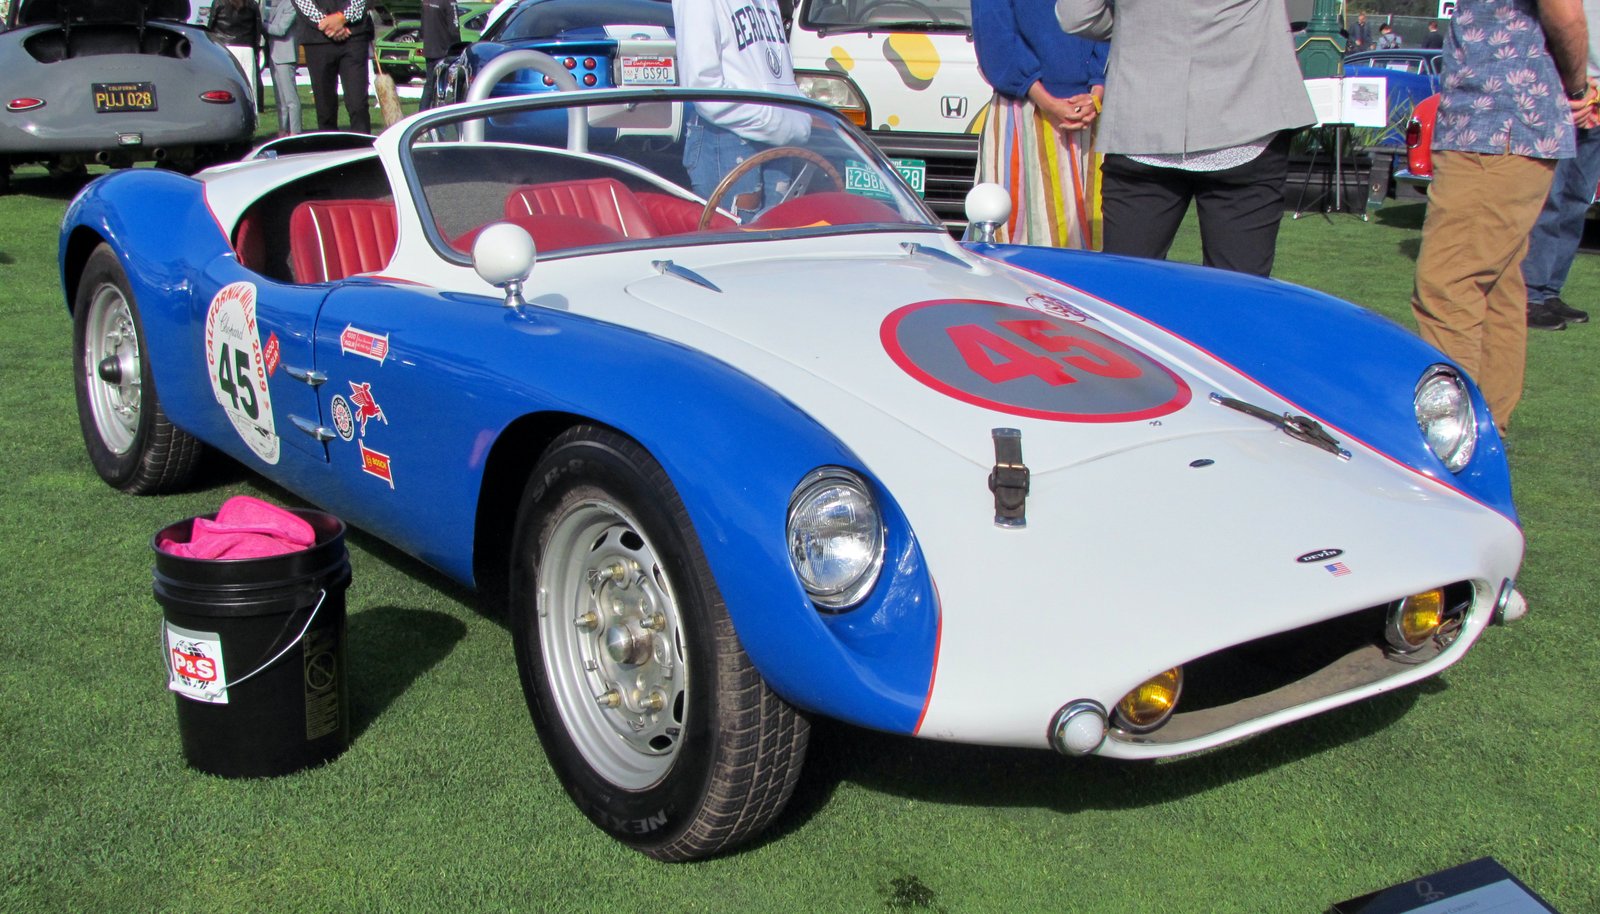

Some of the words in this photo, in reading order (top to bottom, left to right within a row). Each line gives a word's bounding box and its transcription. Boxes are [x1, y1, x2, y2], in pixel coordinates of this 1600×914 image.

[95, 92, 125, 108] PUJ
[127, 91, 152, 107] 028
[207, 284, 246, 366] CALIFORNIA
[240, 287, 256, 335] MILLE
[251, 339, 267, 392] 2009
[944, 319, 1144, 388] 45
[218, 342, 260, 420] 45
[1302, 550, 1338, 561] DEVIN
[174, 651, 215, 679] P&S
